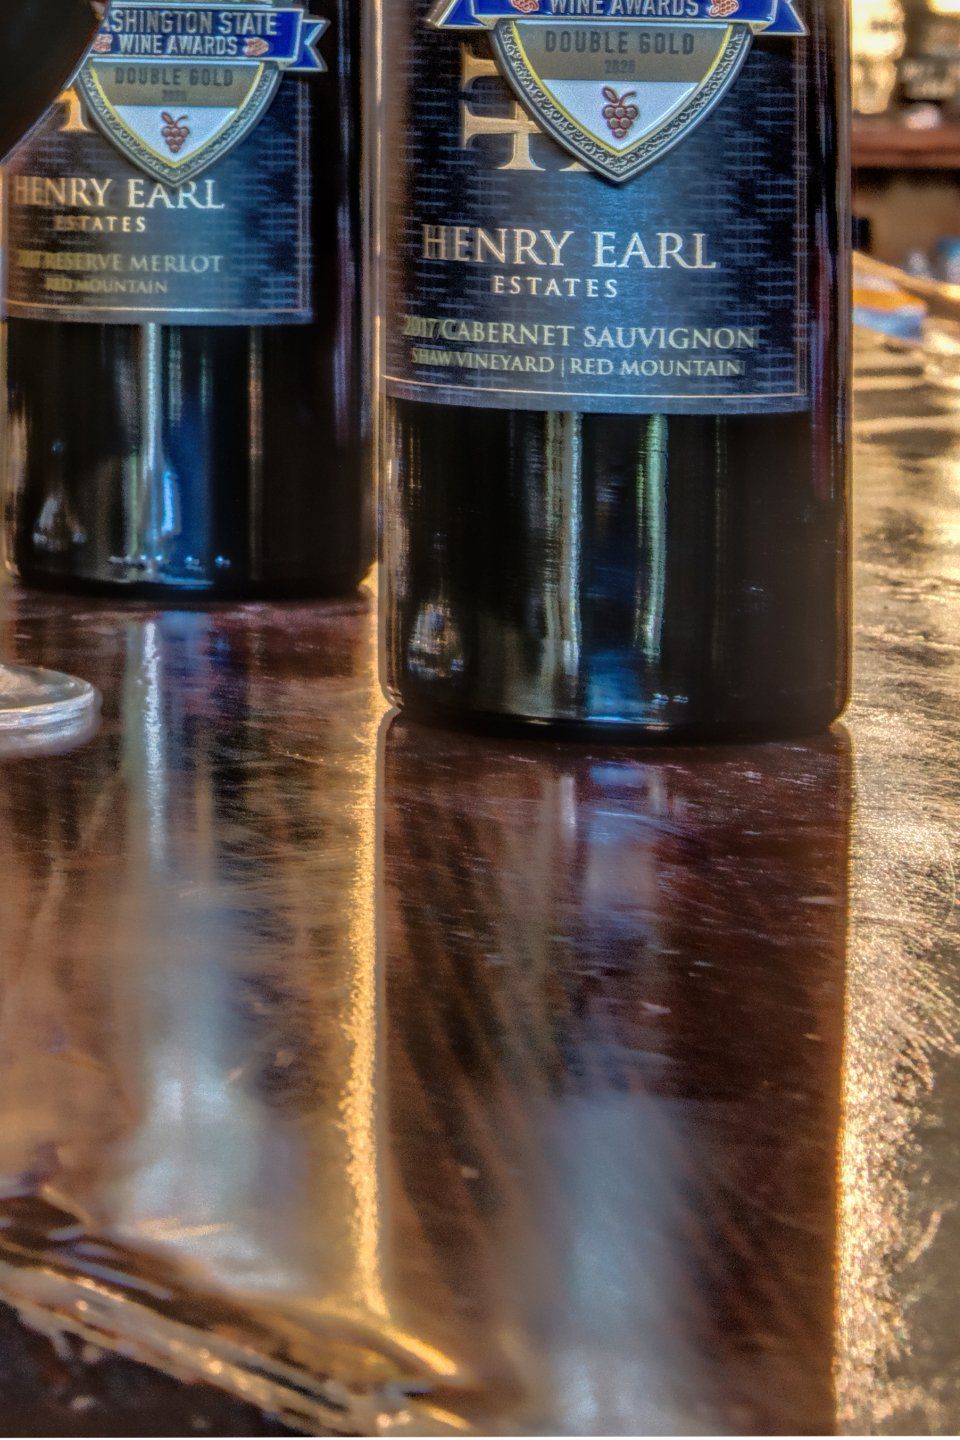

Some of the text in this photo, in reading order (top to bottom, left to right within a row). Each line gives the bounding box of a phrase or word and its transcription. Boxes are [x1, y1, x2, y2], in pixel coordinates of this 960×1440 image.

[218, 12, 278, 36] STATE
[118, 34, 238, 56] WINE AWARDS
[544, 30, 696, 56] DOUBLE GOLD
[114, 67, 234, 87] DOUBLE GOLD
[13, 175, 226, 210] HENRY EARL
[54, 215, 147, 233] ESTATES
[421, 223, 718, 270] HENRY EARL
[129, 254, 224, 274] MERLOT
[493, 275, 619, 298] ESTATES
[441, 318, 575, 348] CABERNET
[583, 326, 758, 350] SAUVIGNON
[453, 352, 556, 375] VINEYARD
[570, 357, 615, 376] RED
[619, 359, 746, 378] MOUNTAIN
